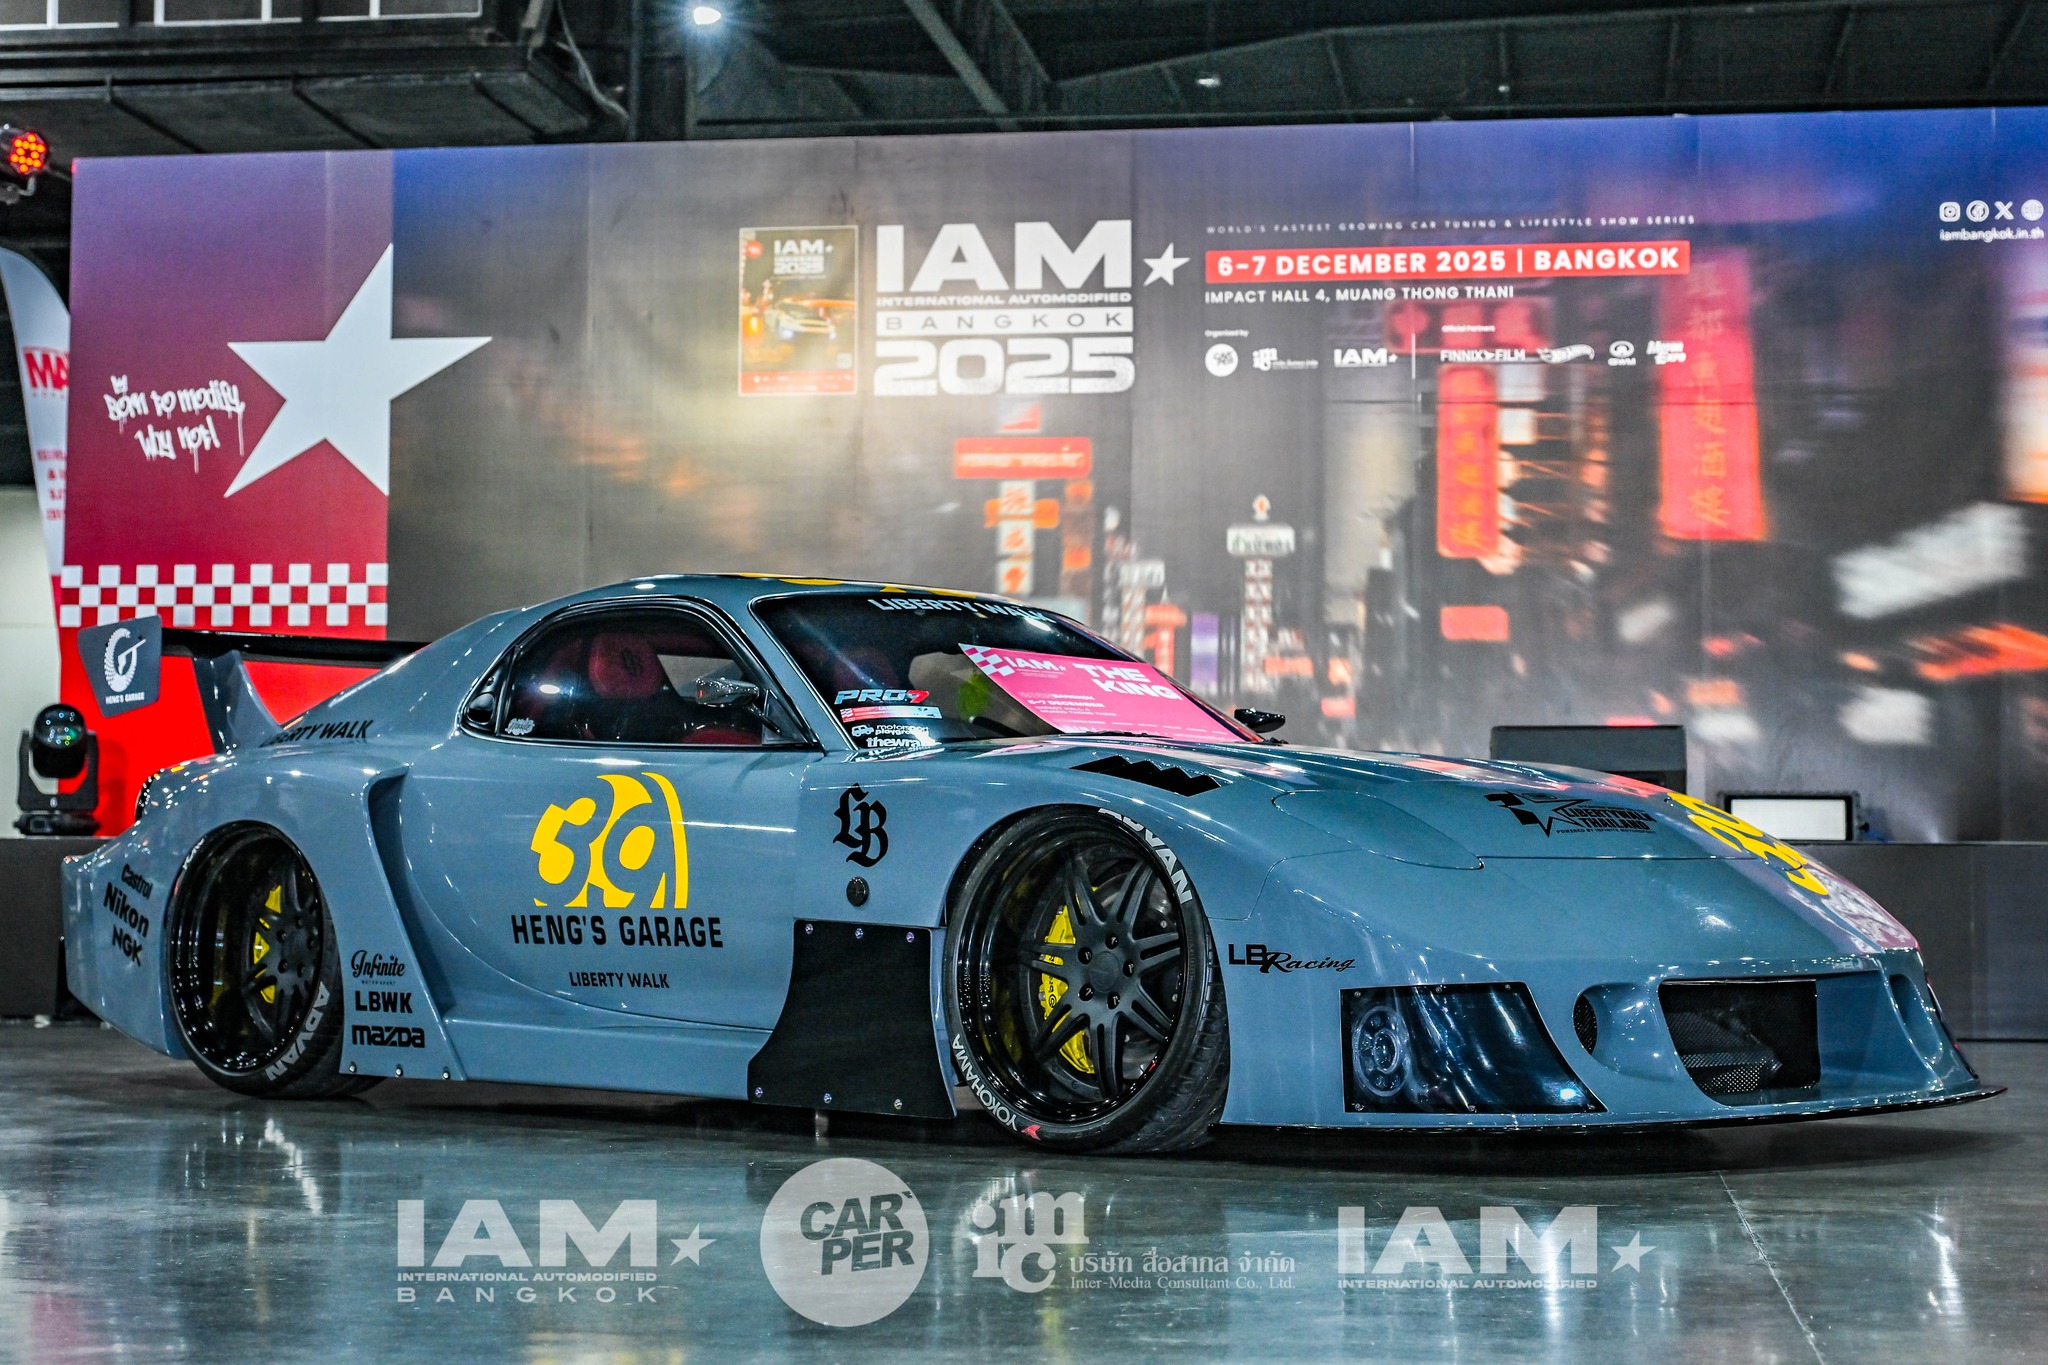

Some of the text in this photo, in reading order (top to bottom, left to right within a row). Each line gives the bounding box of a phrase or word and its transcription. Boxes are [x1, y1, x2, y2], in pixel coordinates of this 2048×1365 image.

[1206, 215, 1695, 234] WORLD'S FASTEST GROWING CAR TUNING & LIFESTYLE SHOW SERIES
[1939, 226, 2045, 243] iambangkok.in.th
[773, 239, 824, 255] IAM
[876, 219, 1132, 292] IAM
[1276, 251, 1427, 276] DECEMBER
[1436, 249, 1506, 273] 2025
[1534, 246, 1680, 271] BANGKOK
[876, 291, 1132, 307] INTERNATIONAL AUTOMODIFIED
[1205, 284, 1514, 305] IMPACT HALL 4, MUANG THONG THANI
[885, 312, 1122, 331] BANGKOK
[873, 336, 1136, 397] 2025
[1334, 347, 1388, 365] IAM
[1440, 349, 1482, 362] FINNIX
[1494, 348, 1526, 362] FILM
[150, 390, 177, 418] to
[177, 379, 246, 416] modify
[134, 414, 221, 461] Why not!
[868, 598, 1057, 624] LIBERTY WALK
[1003, 655, 1059, 672] IAM
[1073, 663, 1151, 683] THE
[1091, 678, 1183, 701] KING
[319, 720, 374, 739] WALK
[866, 736, 921, 748] thewra
[1579, 818, 1651, 831] THAILAND
[121, 864, 154, 900] Castrol
[103, 882, 149, 938] Nikon
[511, 914, 724, 948] HENG'S GARAGE
[112, 925, 142, 967] NGK
[351, 950, 406, 978] Infinite
[1260, 951, 1356, 974] Racing
[569, 971, 670, 989] LIBERTY WALK
[354, 990, 413, 1013] LBWK
[265, 981, 330, 1082] ADVAN
[352, 1024, 426, 1049] mazda
[952, 1033, 1018, 1132] YOKOHAMA
